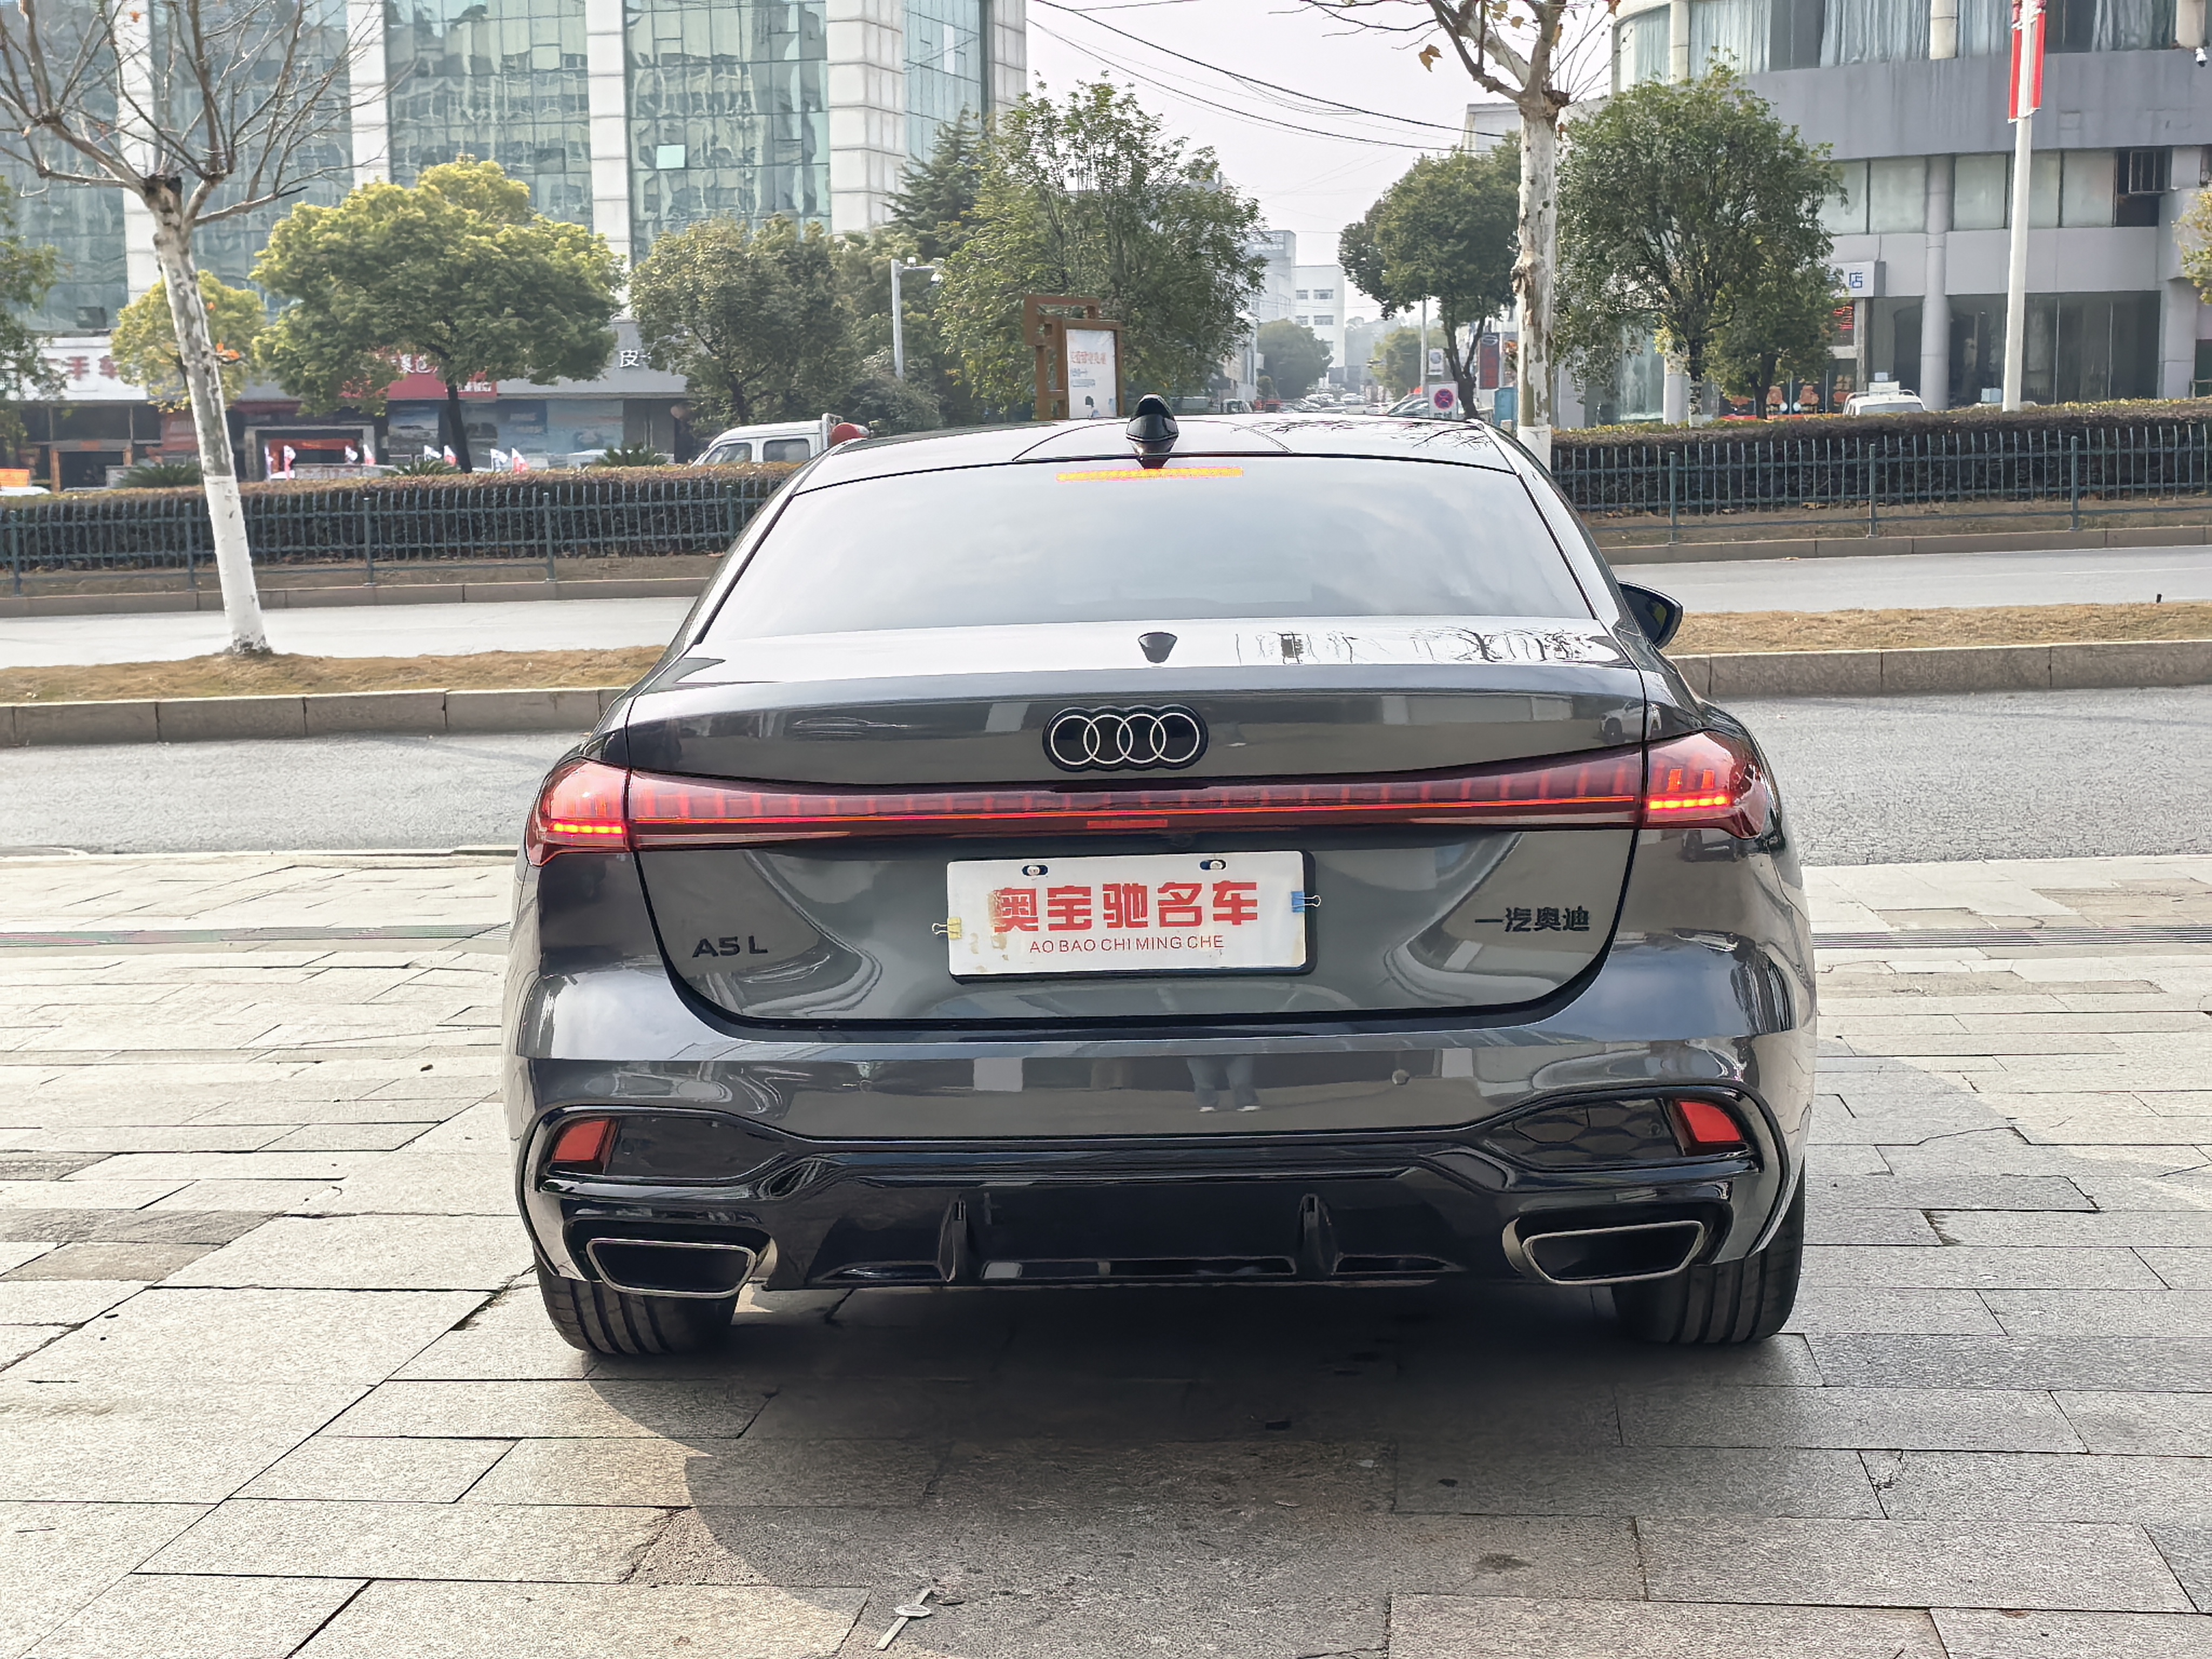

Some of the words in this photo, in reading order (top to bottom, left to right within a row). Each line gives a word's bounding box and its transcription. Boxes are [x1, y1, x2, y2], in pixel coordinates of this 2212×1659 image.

[995, 881, 1257, 933] 奥宝驰名车
[1474, 905, 1590, 933] 一汽奥迪
[1135, 936, 1182, 950] MING
[1187, 935, 1224, 949] CHE
